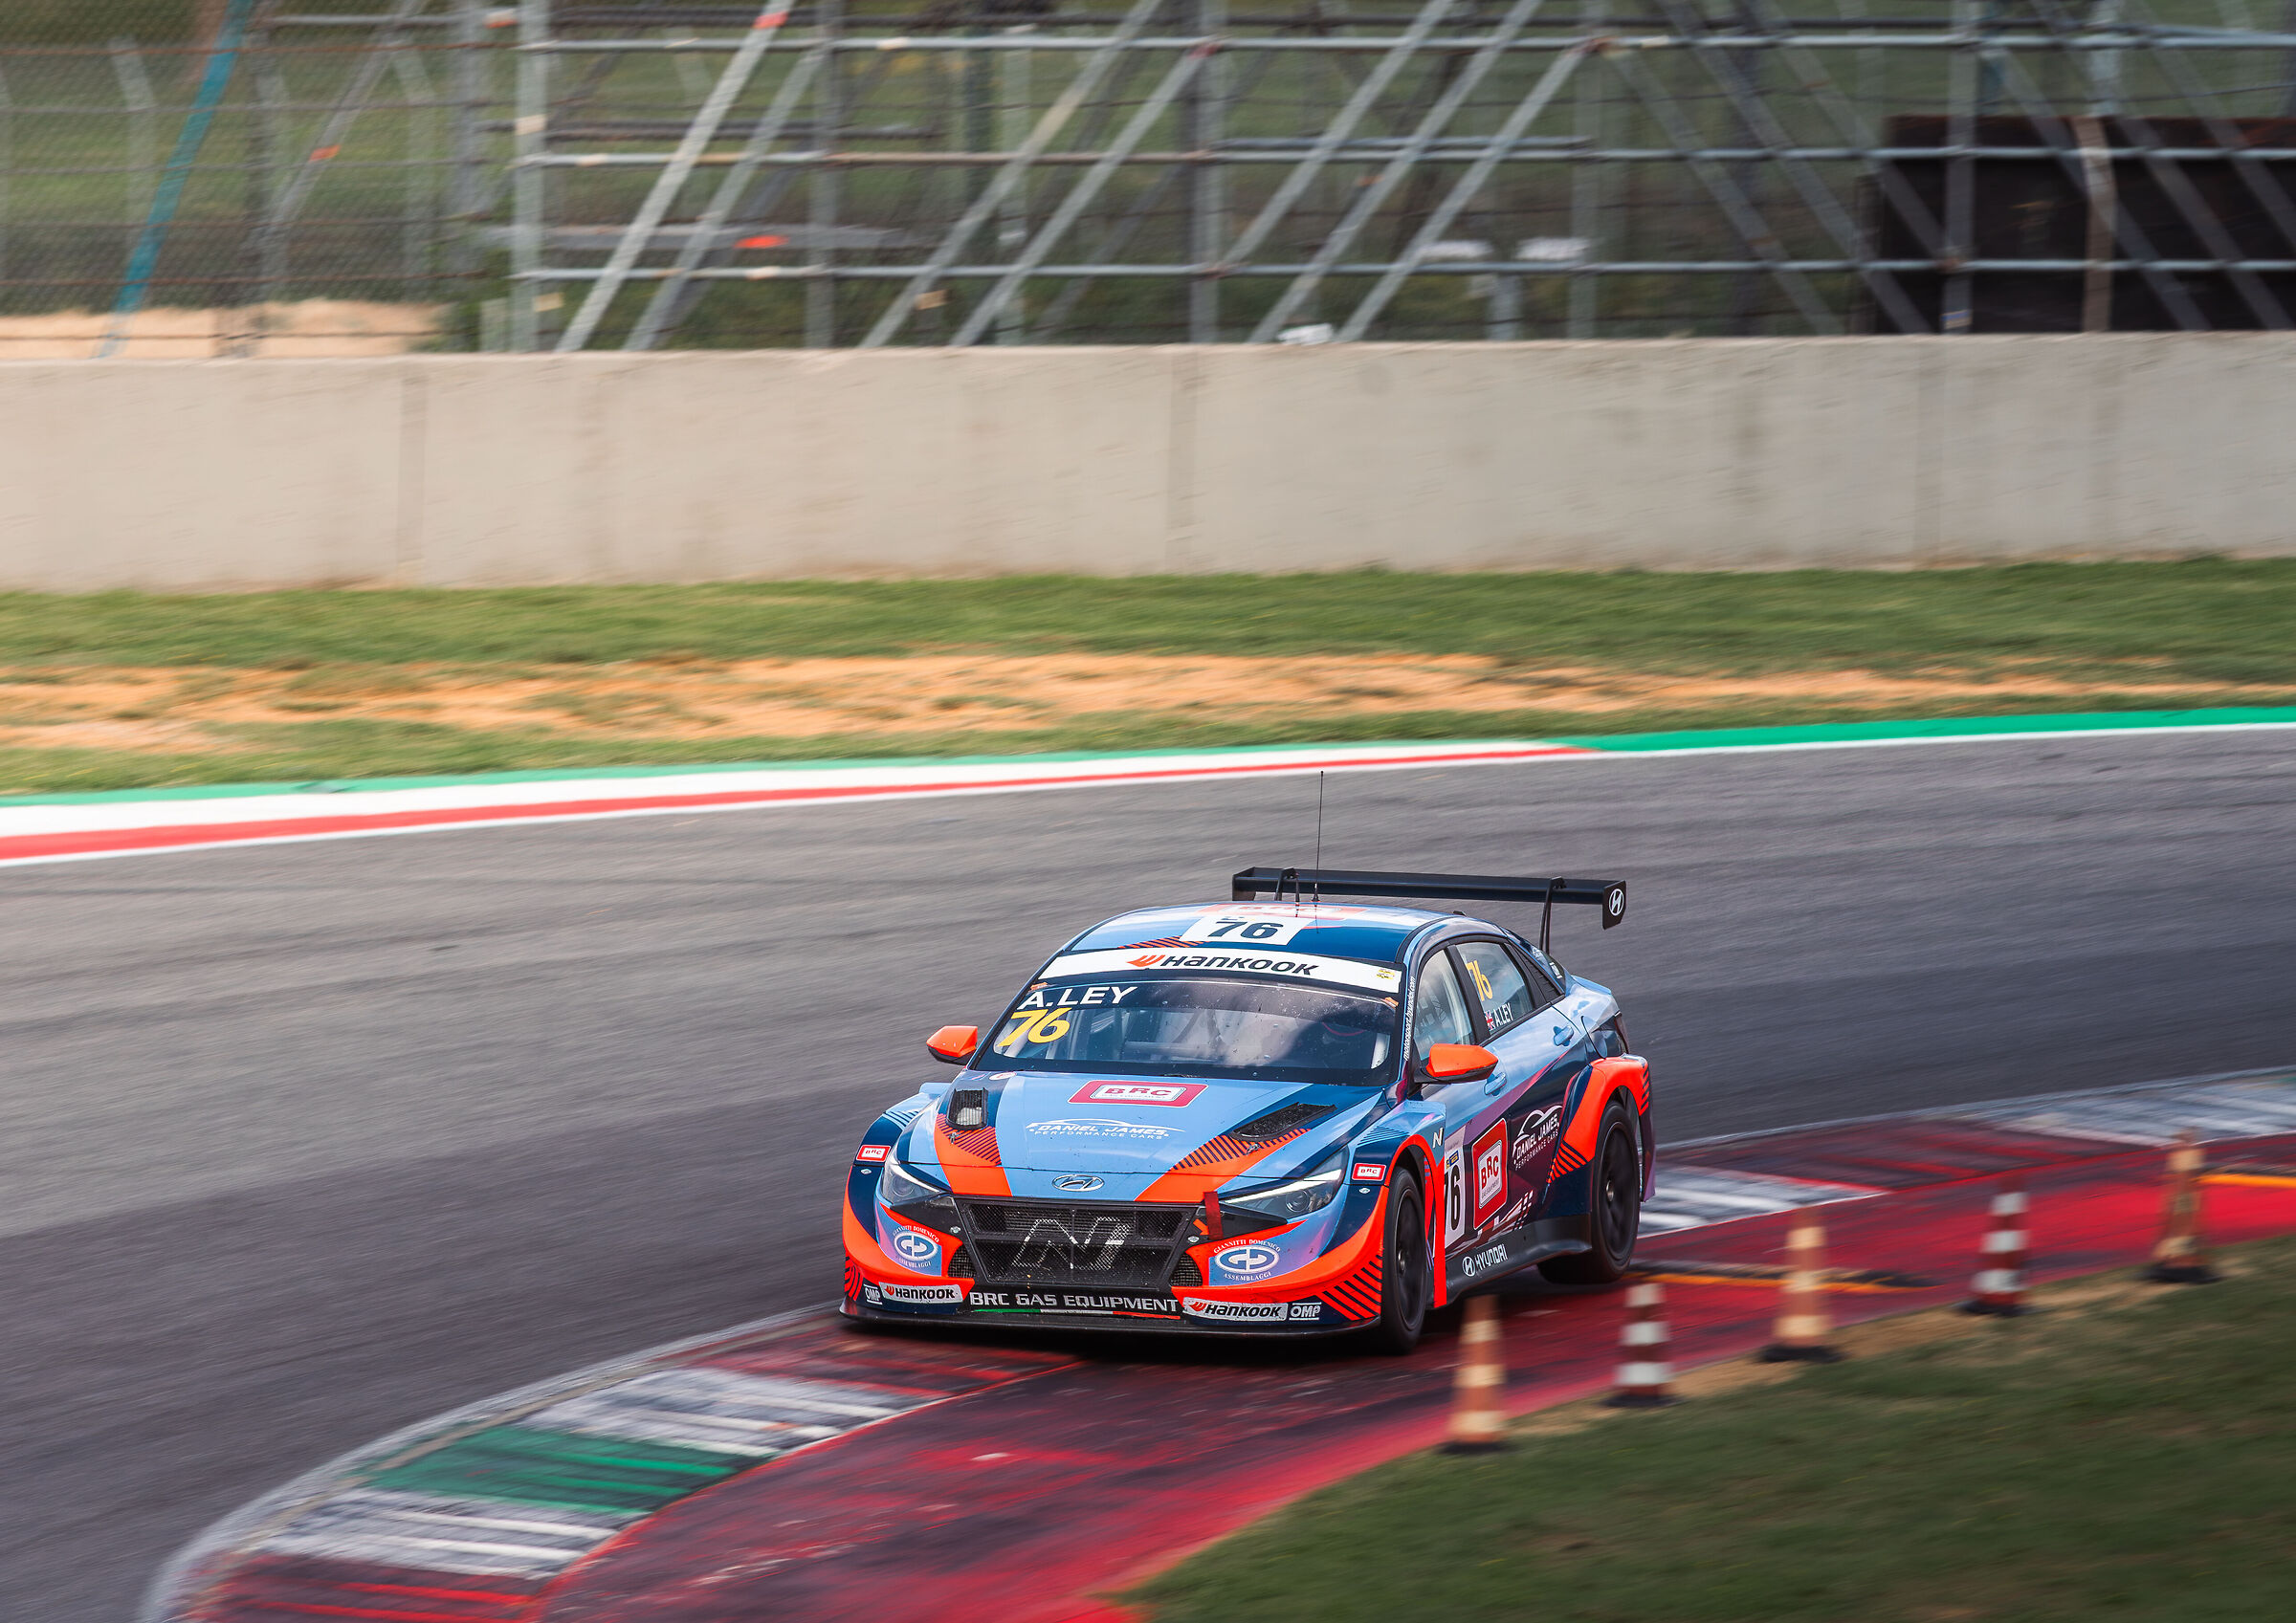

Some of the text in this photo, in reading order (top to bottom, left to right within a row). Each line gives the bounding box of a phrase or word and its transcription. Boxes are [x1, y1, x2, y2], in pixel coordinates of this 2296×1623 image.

[1207, 921, 1284, 939] 76
[1466, 960, 1493, 1001] 76
[1016, 986, 1137, 1010] A.LEY
[1493, 1002, 1514, 1027] A.LEY
[997, 1007, 1072, 1047] 76
[1104, 1087, 1172, 1096] BRC
[1515, 1129, 1558, 1172] PERFORMANCE CARS
[1516, 1132, 1537, 1160] DANIEL
[1481, 1154, 1499, 1190] BRC
[913, 1225, 939, 1243] DOMENICO
[1213, 1239, 1281, 1254] GIANNITTI DOMENICO
[1474, 1243, 1508, 1270] HYUNDAI
[1224, 1271, 1271, 1282] ASSEMBLAGGI
[864, 1286, 881, 1302] OMP
[969, 1292, 1181, 1312] BRC GAS EQUIPMENT
[1291, 1304, 1321, 1318] OMP
